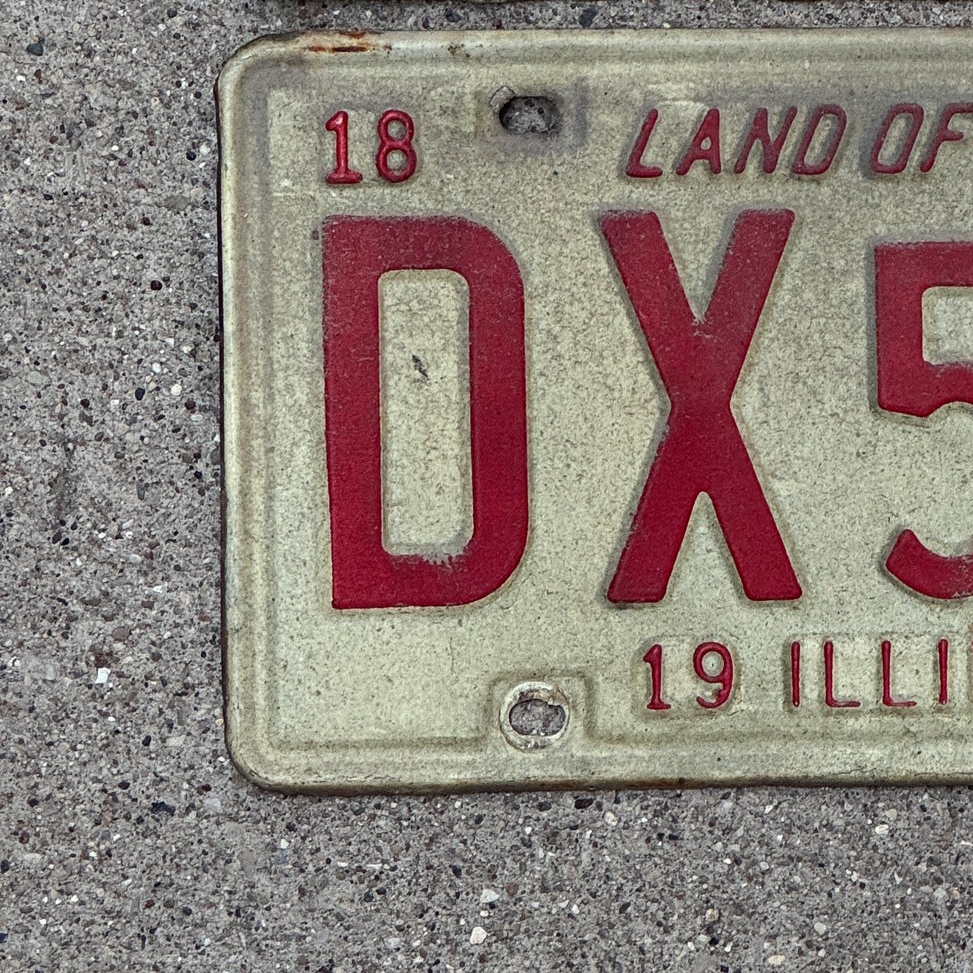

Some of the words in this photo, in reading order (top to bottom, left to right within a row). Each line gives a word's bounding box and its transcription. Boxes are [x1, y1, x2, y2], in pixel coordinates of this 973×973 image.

[323, 108, 418, 184] 18
[626, 103, 850, 177] LAND
[643, 639, 735, 712] 19
